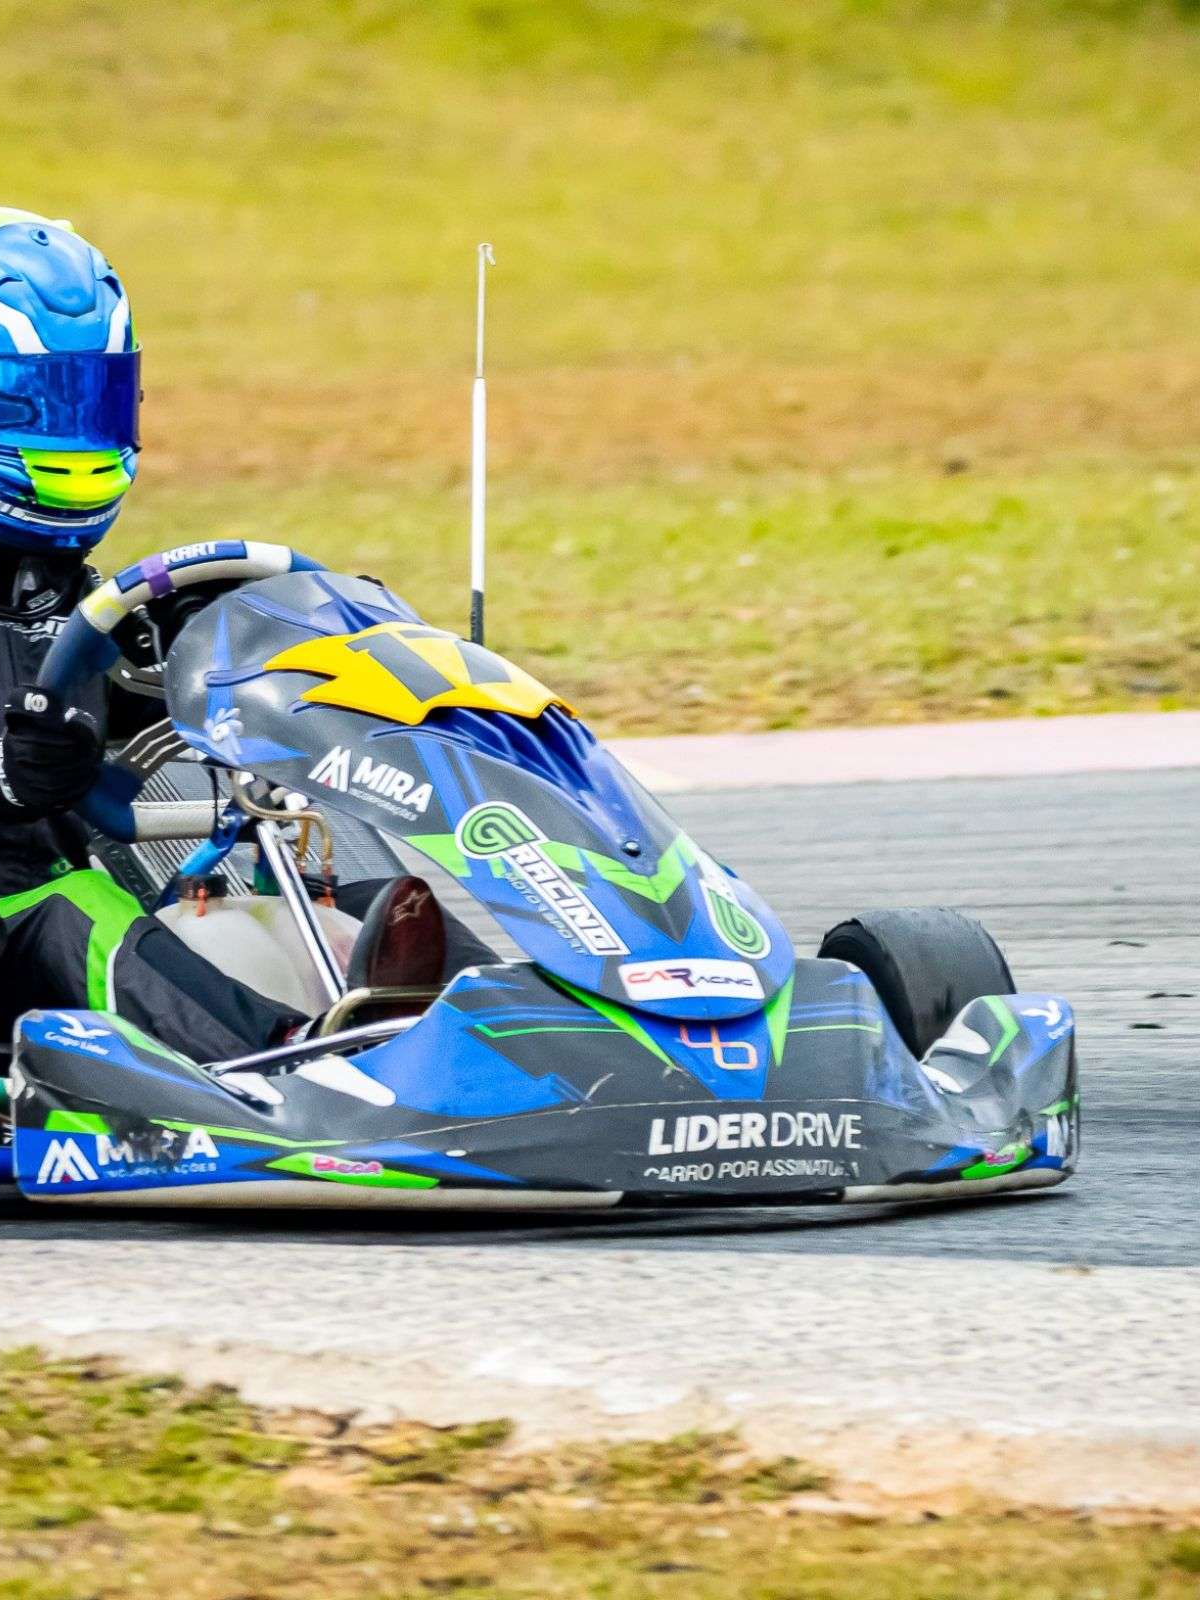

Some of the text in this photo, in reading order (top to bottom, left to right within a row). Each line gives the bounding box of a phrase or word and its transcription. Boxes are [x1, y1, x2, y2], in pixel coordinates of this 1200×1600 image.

[351, 755, 434, 813] MIRA
[503, 841, 623, 951] RACING
[96, 1127, 220, 1166] MRA
[648, 1111, 862, 1155] LIDER DRIVE
[717, 1160, 760, 1179] POR
